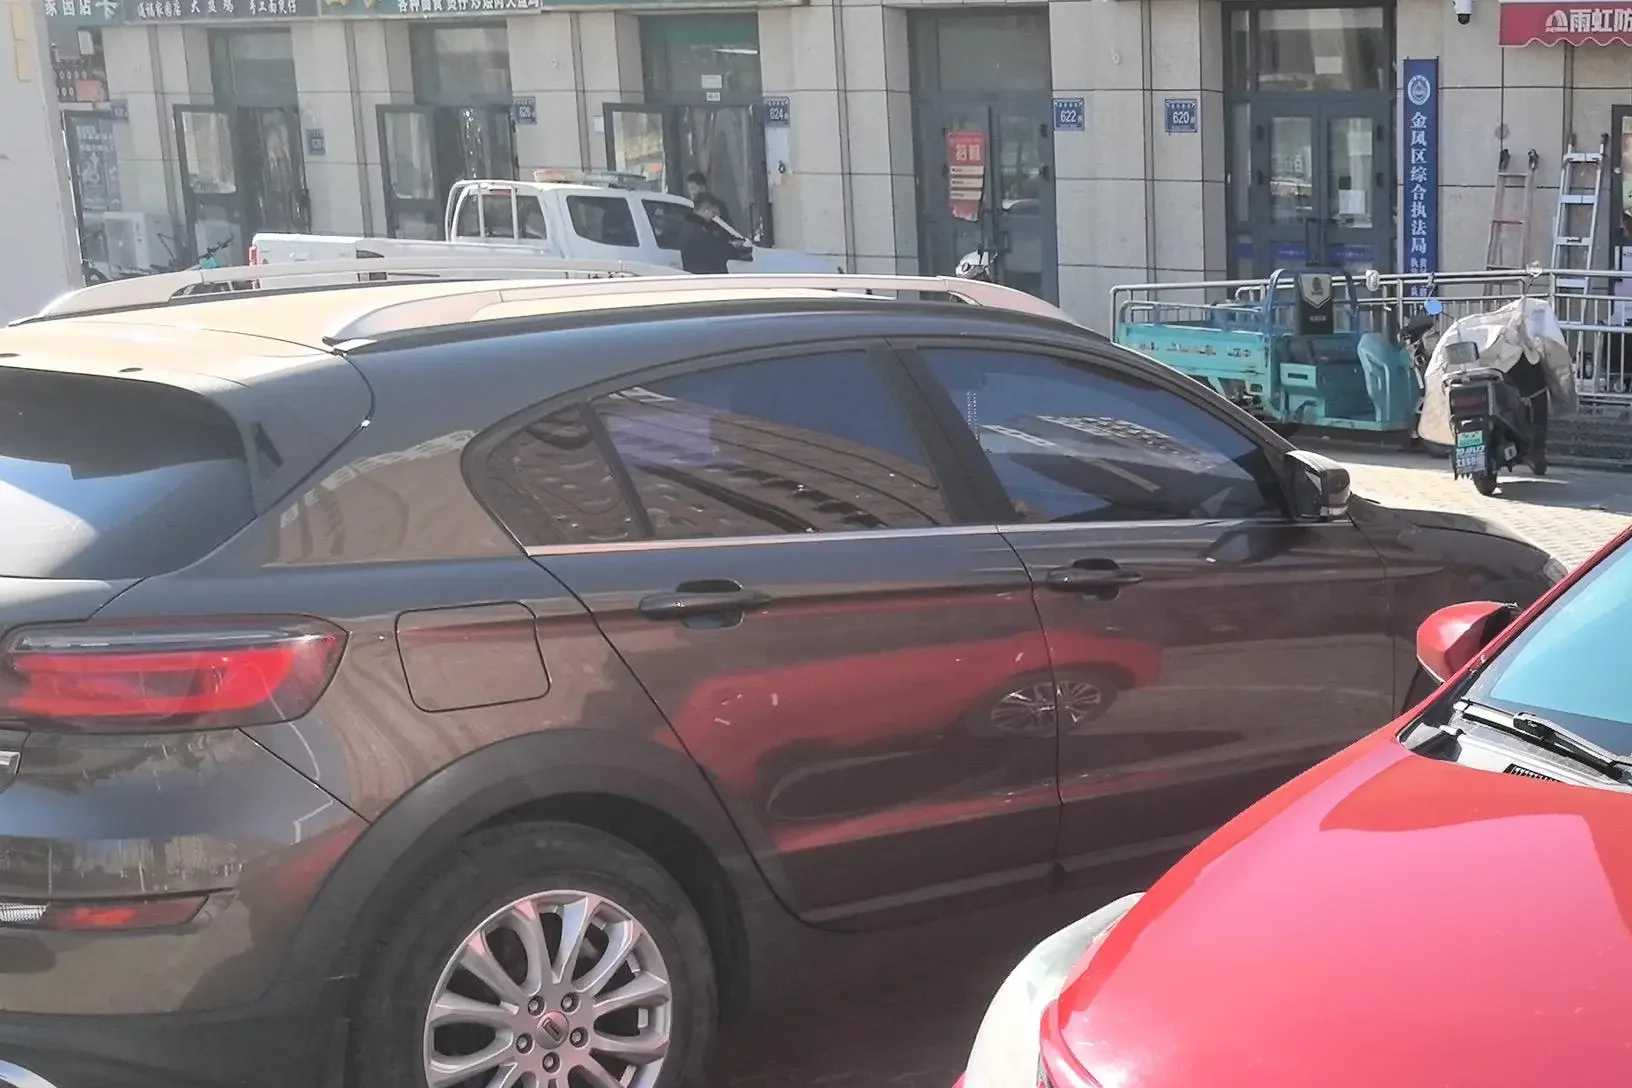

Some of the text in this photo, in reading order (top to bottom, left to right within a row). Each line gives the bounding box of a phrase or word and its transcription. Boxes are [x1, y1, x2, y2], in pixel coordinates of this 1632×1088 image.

[1060, 110, 1077, 123] 622
[1172, 111, 1190, 124] 620
[1410, 111, 1428, 254] 金凤区综合执法局
